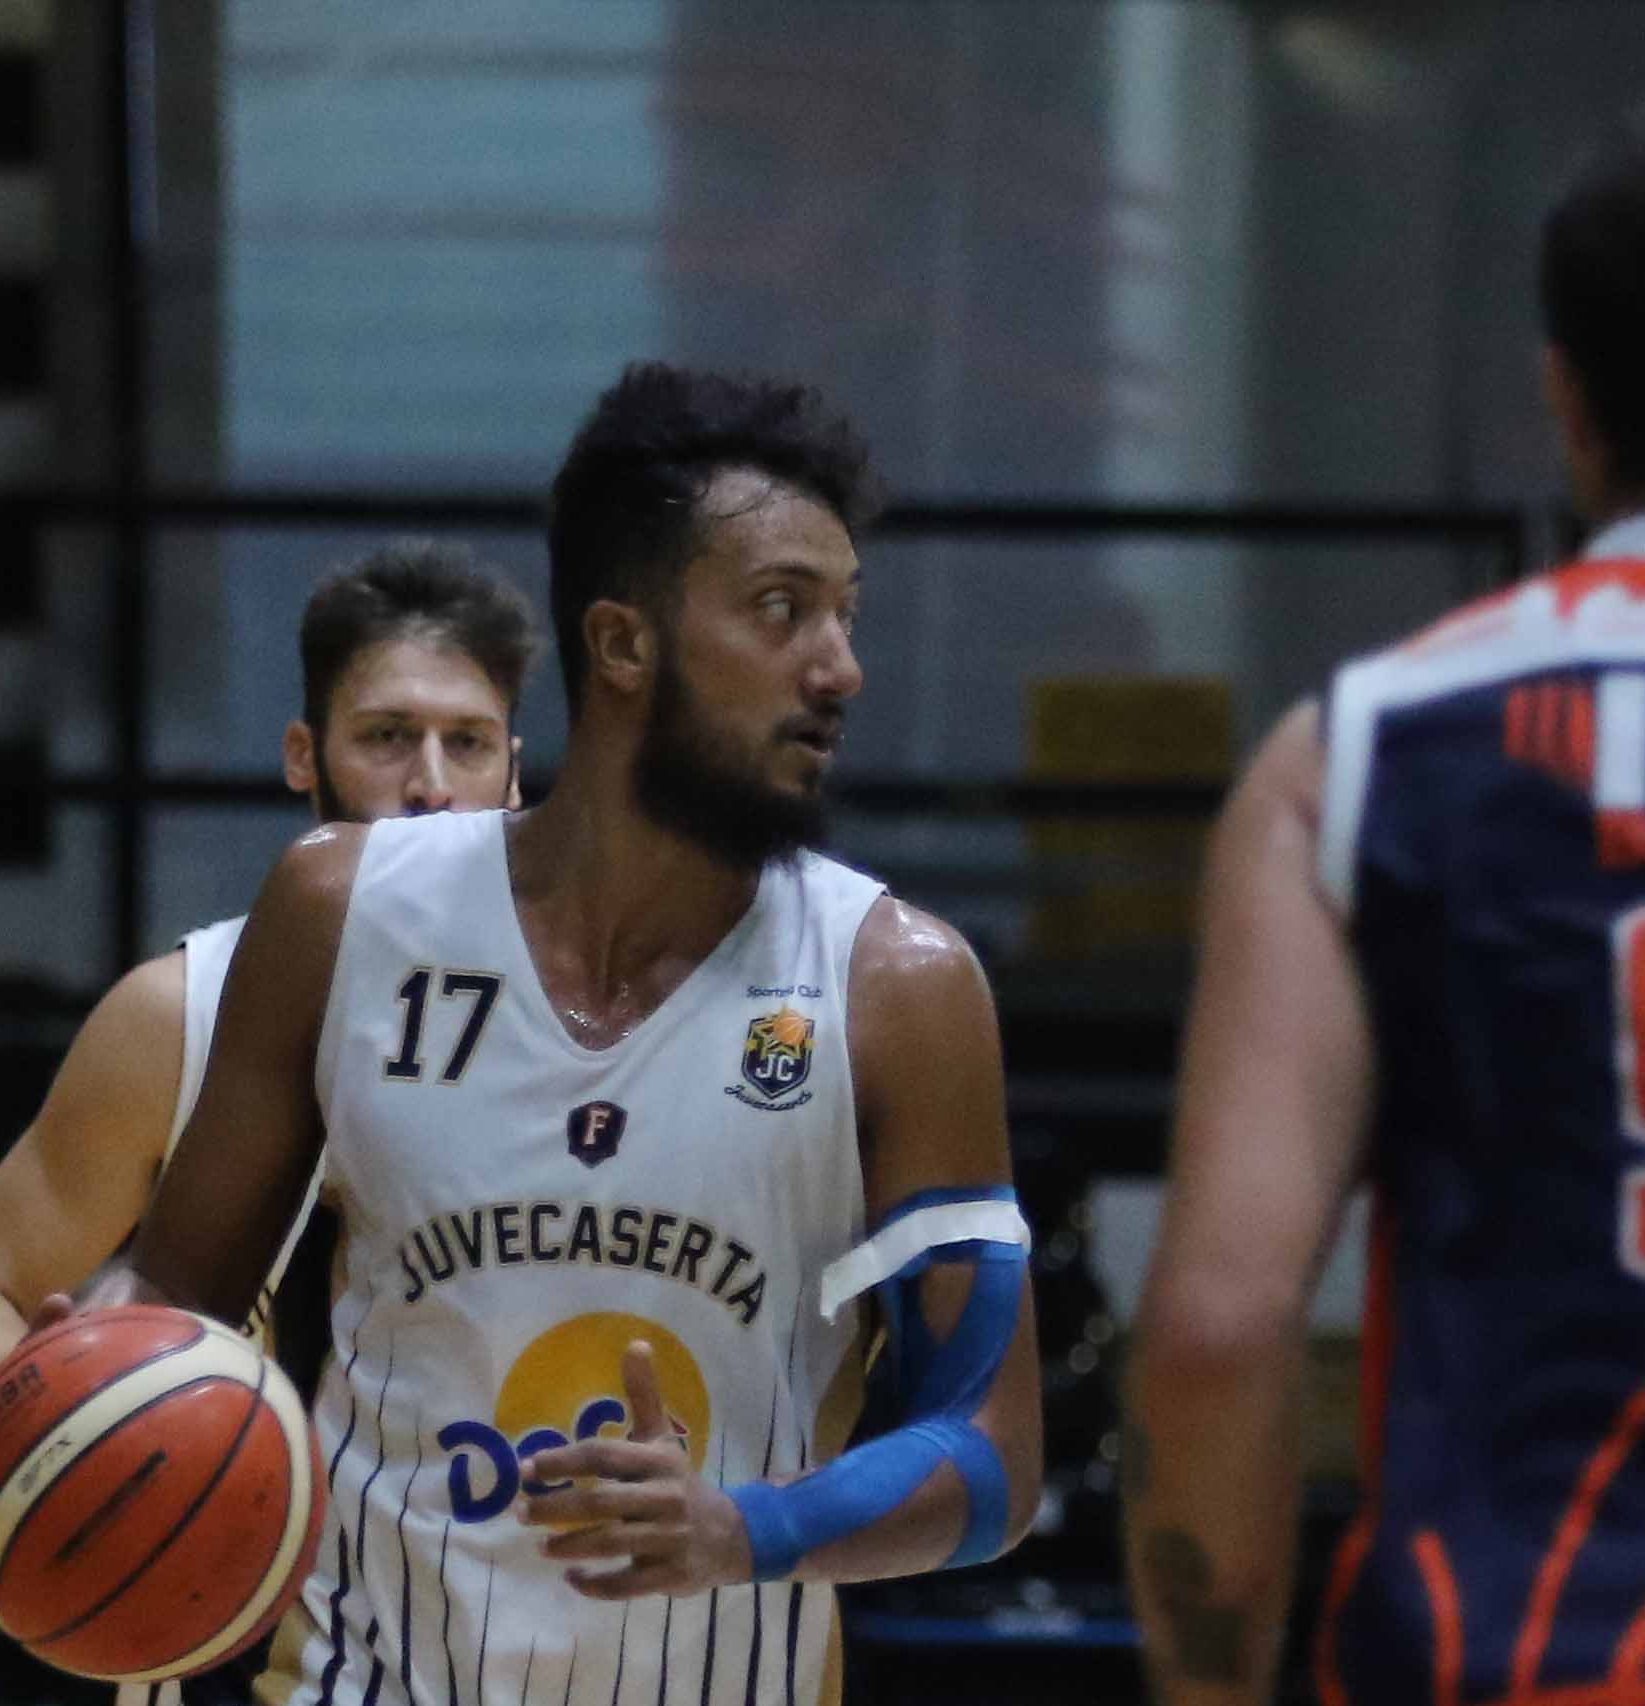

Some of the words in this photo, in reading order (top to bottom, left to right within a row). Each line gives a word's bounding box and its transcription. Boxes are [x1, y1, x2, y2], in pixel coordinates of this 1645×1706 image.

[383, 966, 505, 1085] 17
[754, 1053, 796, 1082] JC
[584, 1110, 609, 1146] F
[398, 1203, 769, 1330] JUVECASERTA
